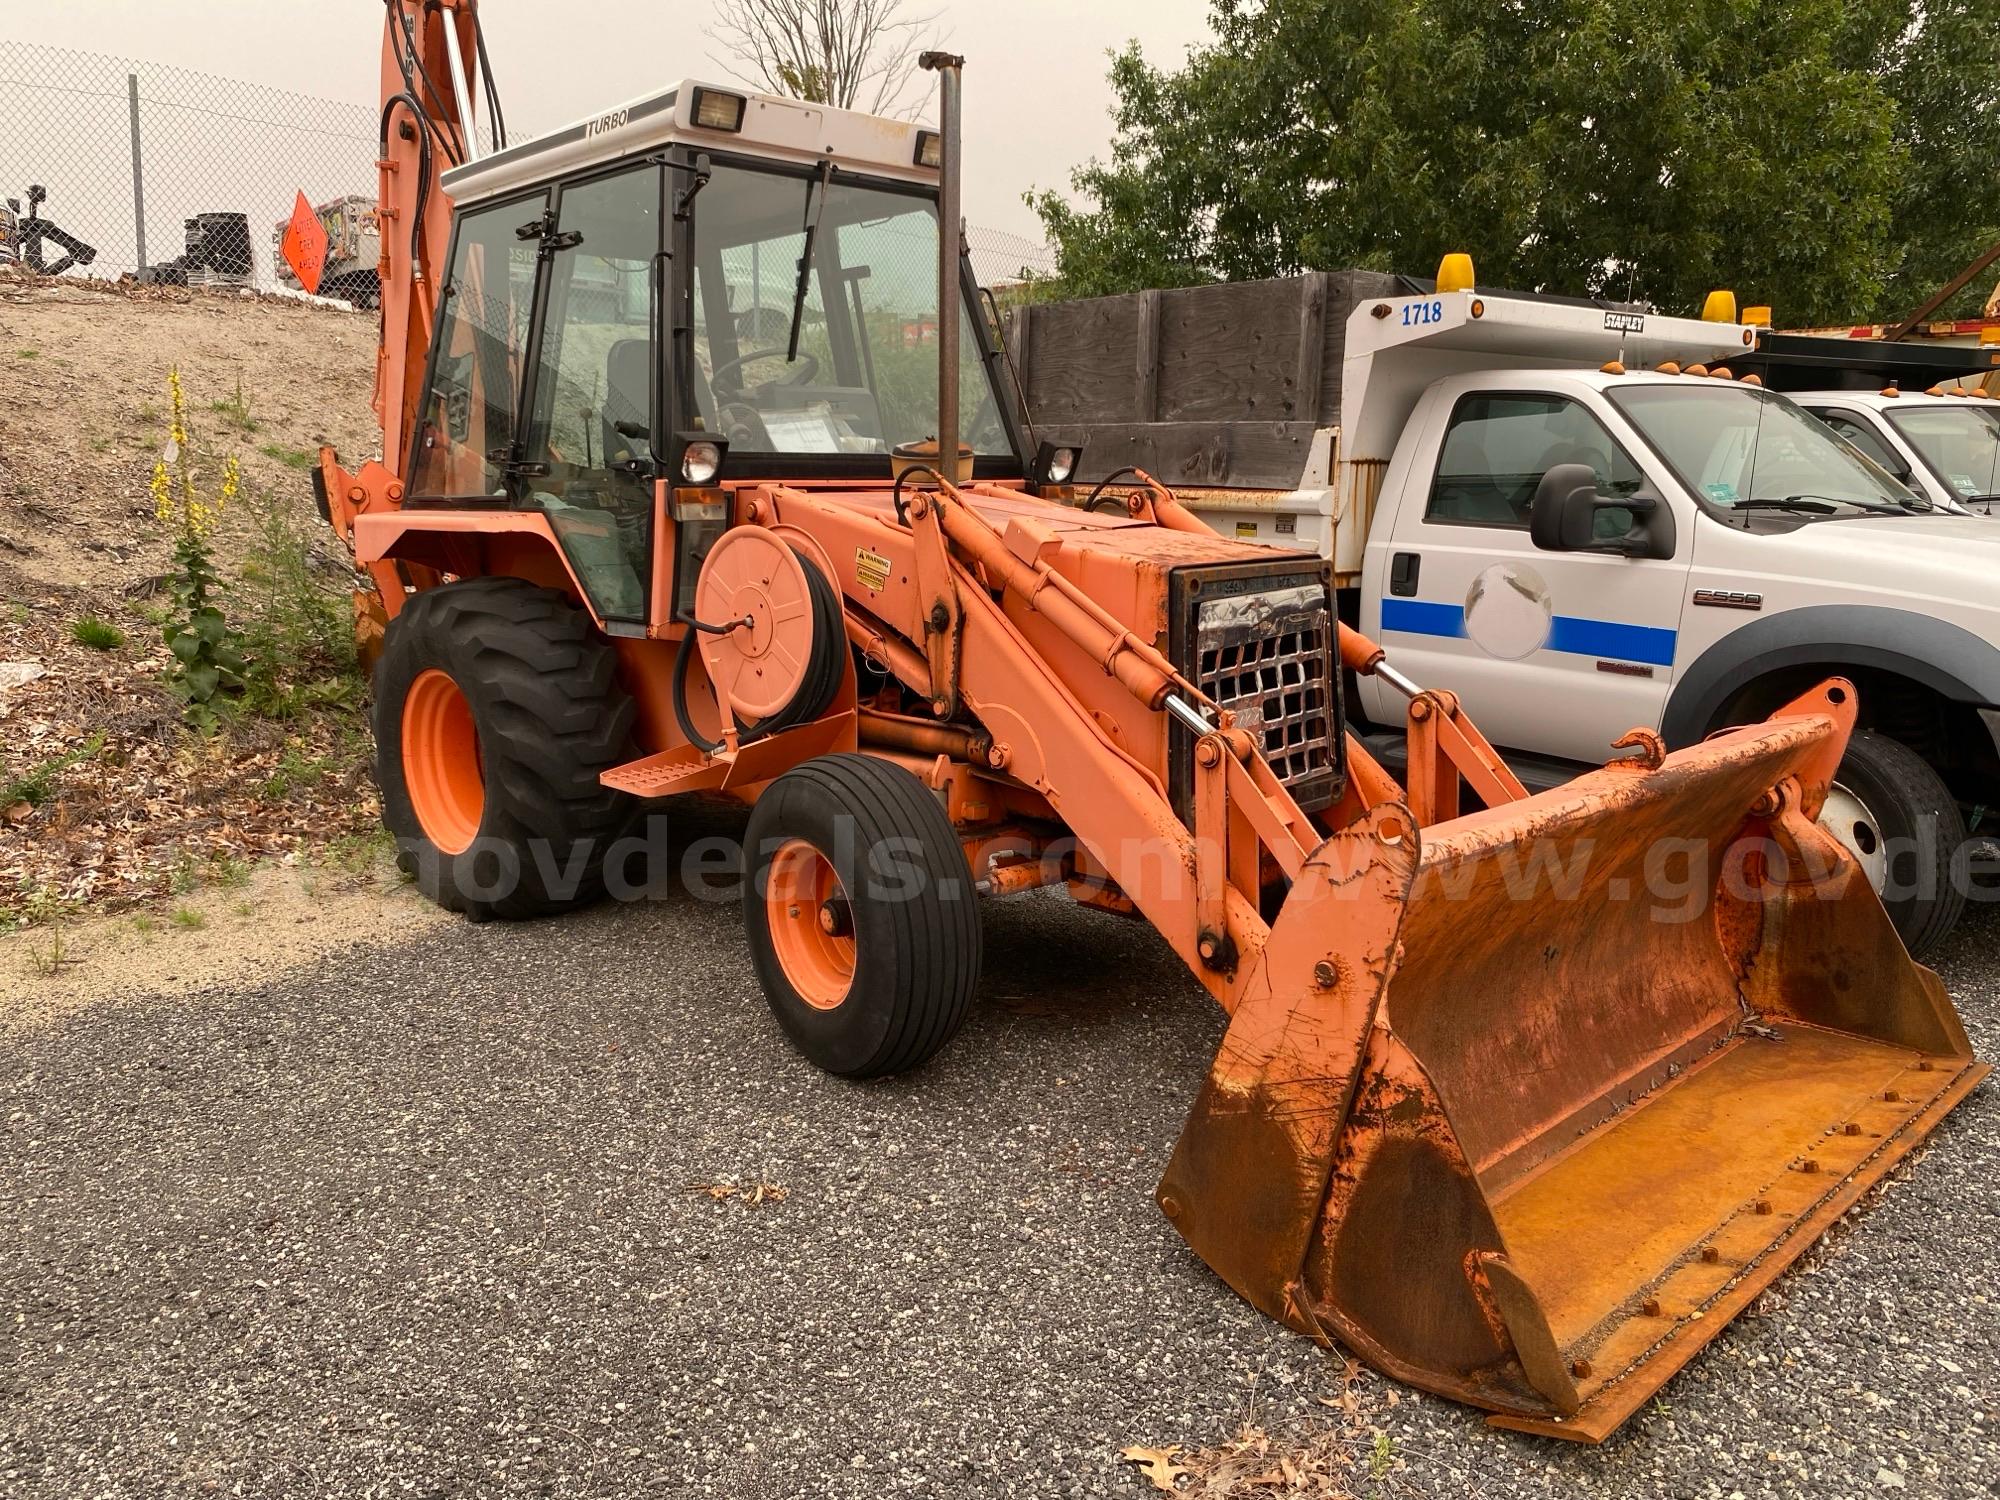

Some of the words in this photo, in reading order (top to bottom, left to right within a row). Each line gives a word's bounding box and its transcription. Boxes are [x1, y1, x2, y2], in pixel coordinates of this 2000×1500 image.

[588, 109, 627, 137] TURBO
[1402, 301, 1442, 326] 1718
[865, 553, 889, 568] WARNING
